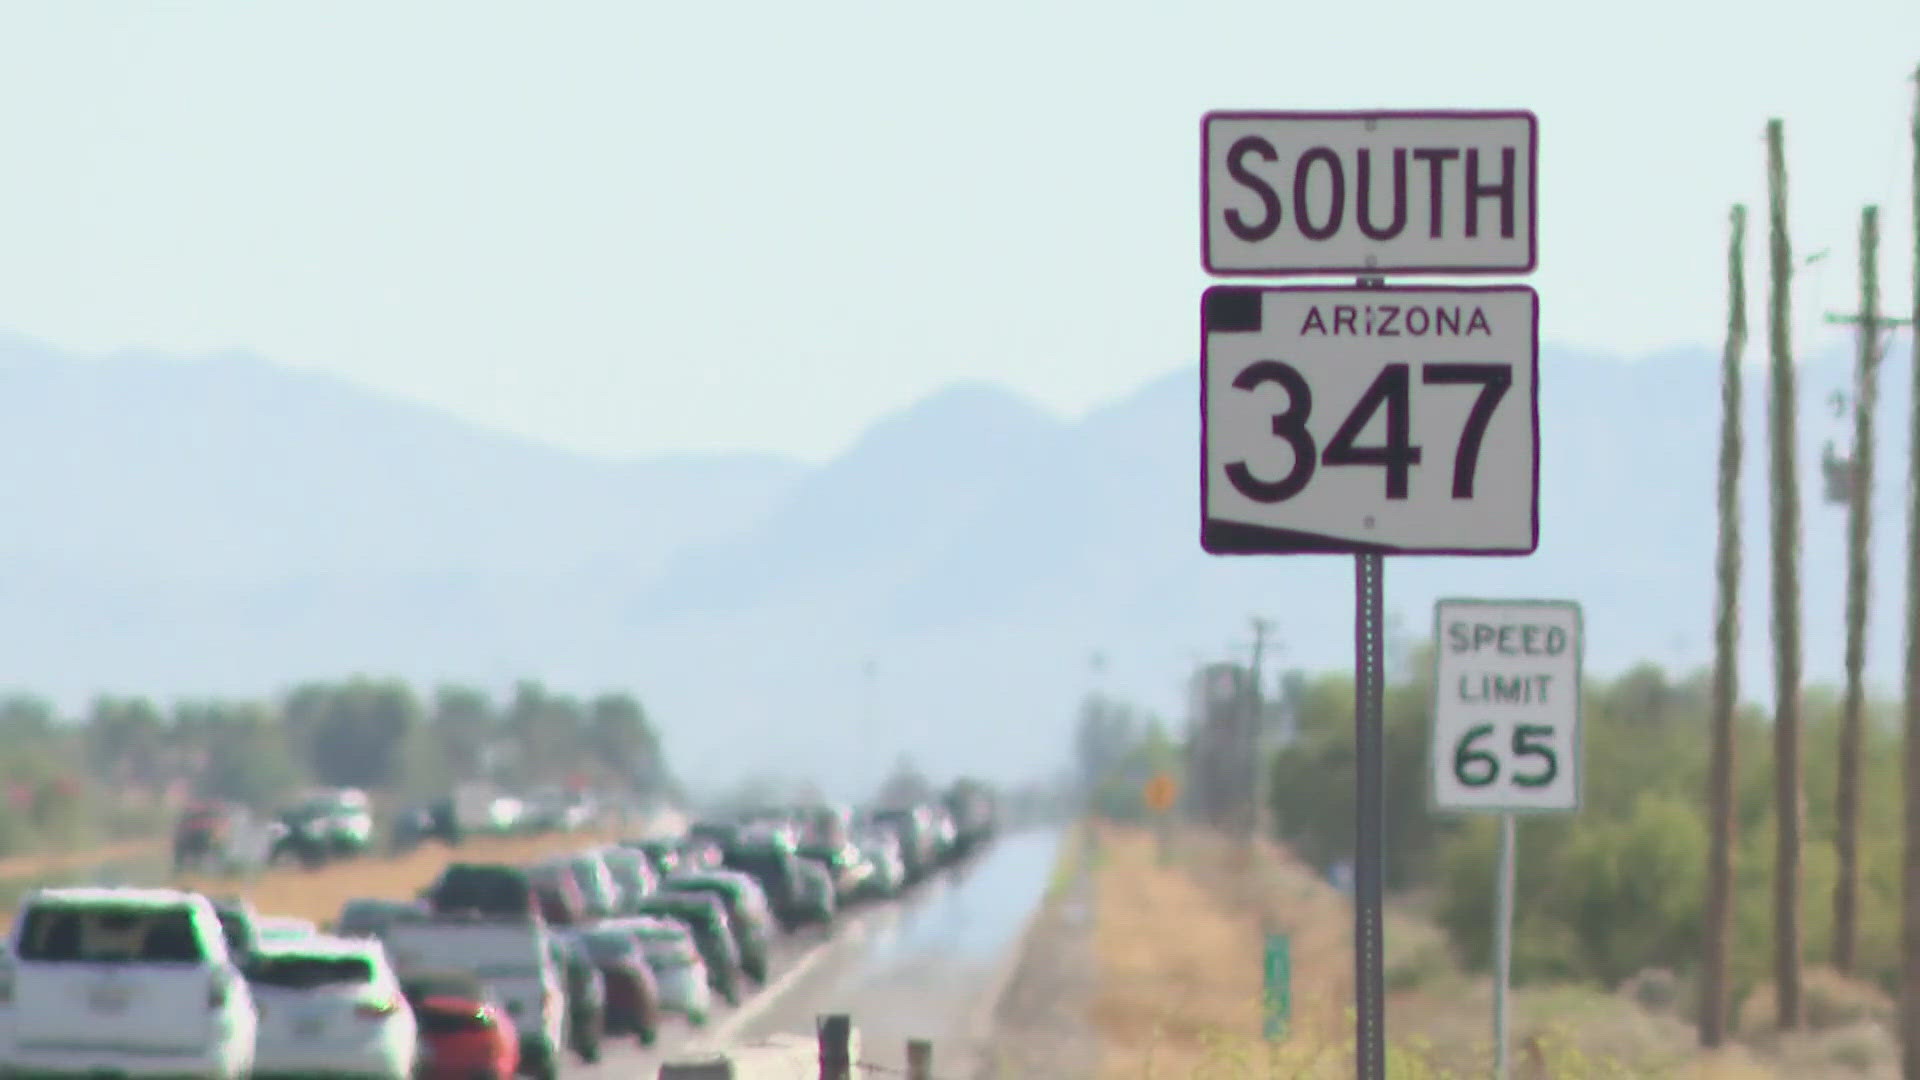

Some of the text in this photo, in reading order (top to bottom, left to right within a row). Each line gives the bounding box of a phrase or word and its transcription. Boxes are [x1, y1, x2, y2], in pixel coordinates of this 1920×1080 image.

[1223, 135, 1515, 242] SOUTH
[1300, 306, 1492, 336] ARIZONA
[1224, 360, 1513, 504] 347
[1448, 621, 1566, 655] SPEED
[1459, 673, 1552, 704] LIMIT
[1454, 723, 1558, 787] 65
